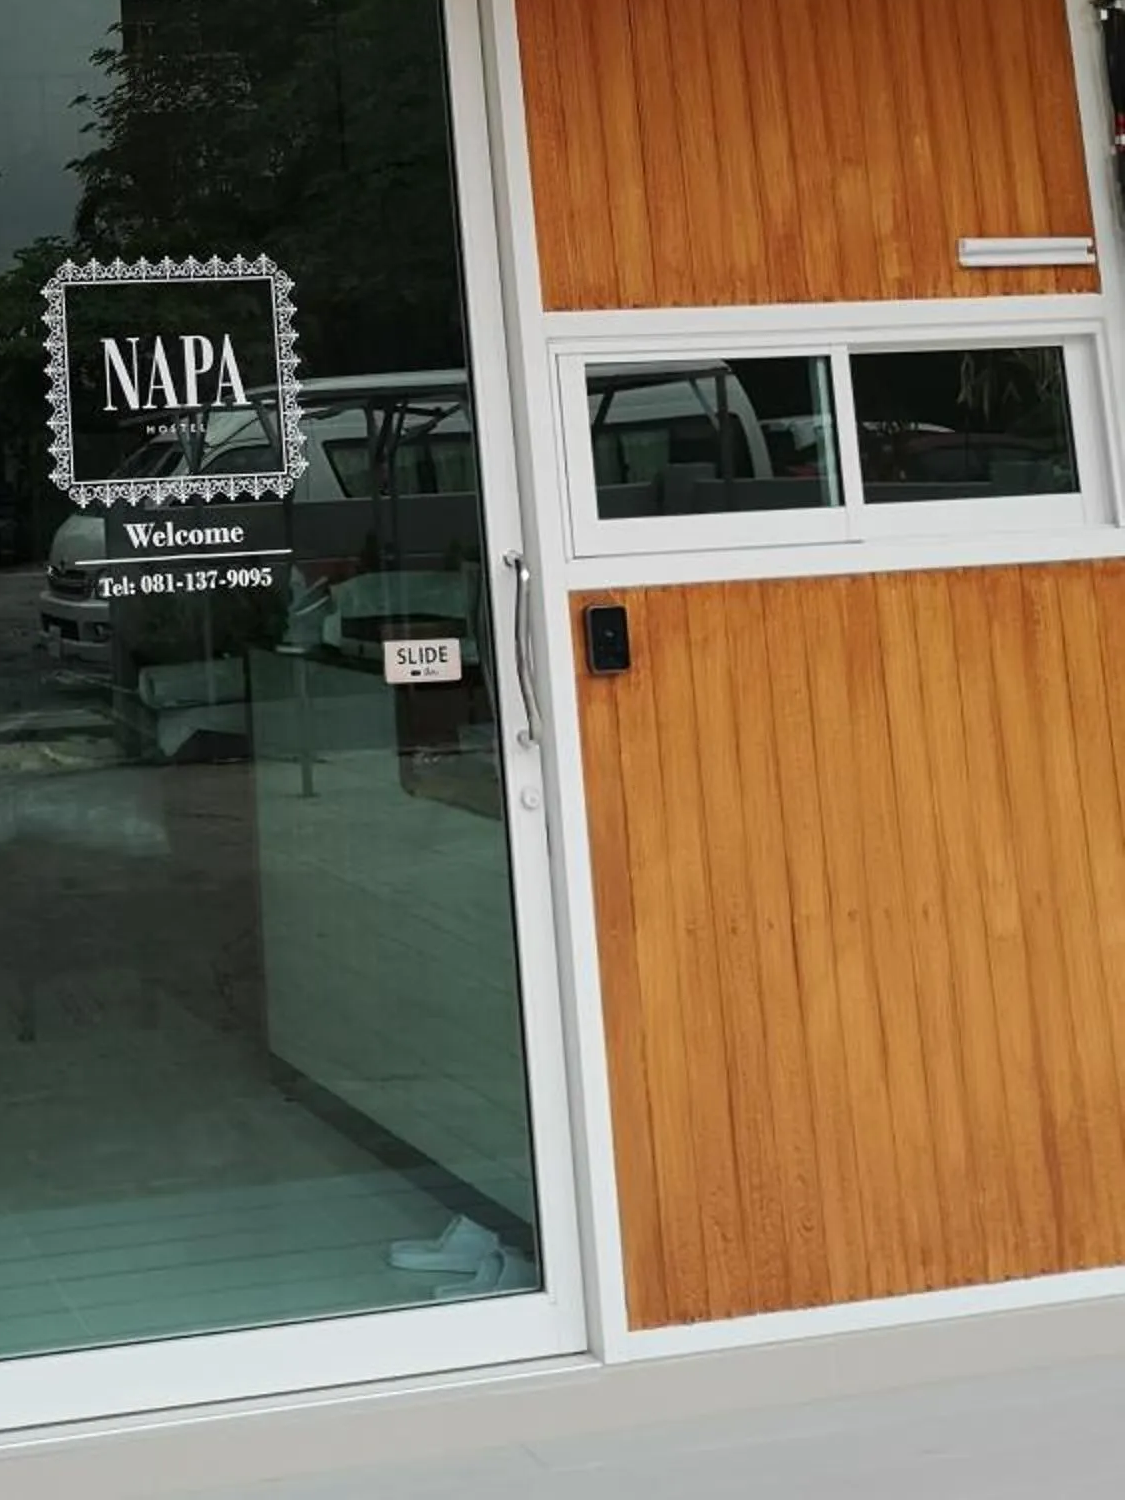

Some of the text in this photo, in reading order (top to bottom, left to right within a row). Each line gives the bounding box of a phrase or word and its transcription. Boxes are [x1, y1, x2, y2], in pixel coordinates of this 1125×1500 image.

[99, 333, 252, 411] NAPA
[146, 423, 206, 435] HOSTEL
[123, 521, 245, 549] Welcome
[98, 568, 273, 598] Tel: 081-137-9095
[396, 645, 449, 665] SLIDE
